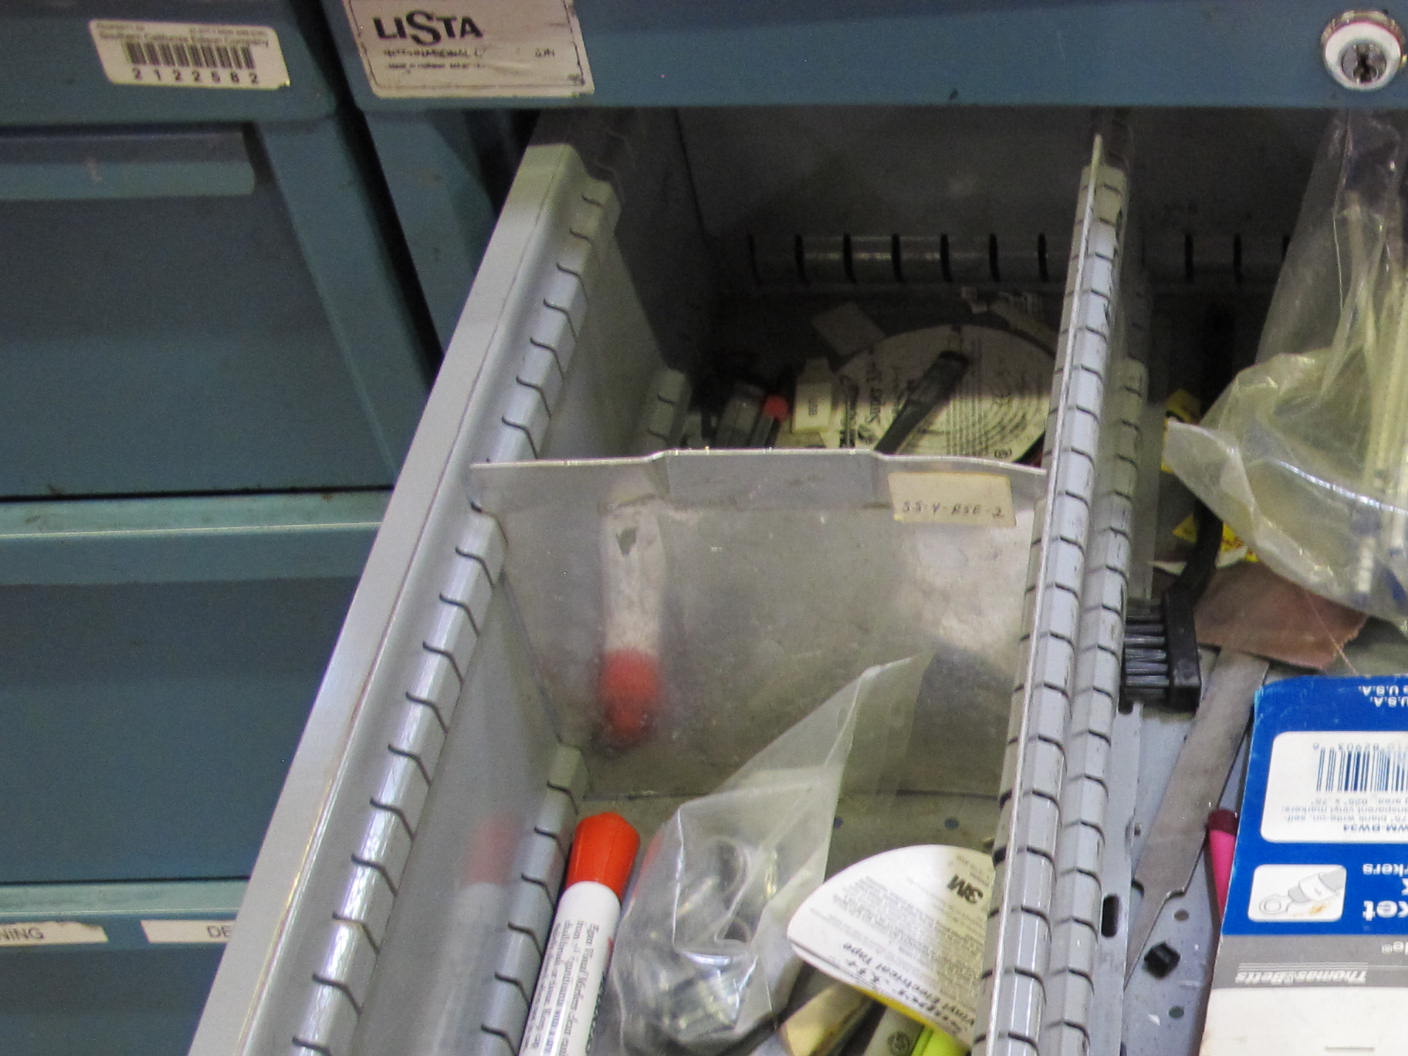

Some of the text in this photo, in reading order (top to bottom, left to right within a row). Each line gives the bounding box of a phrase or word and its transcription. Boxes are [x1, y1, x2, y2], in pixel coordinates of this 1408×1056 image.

[373, 10, 484, 46] LISTA
[1358, 685, 1399, 695] U.S.A.
[945, 873, 985, 904] 3M
